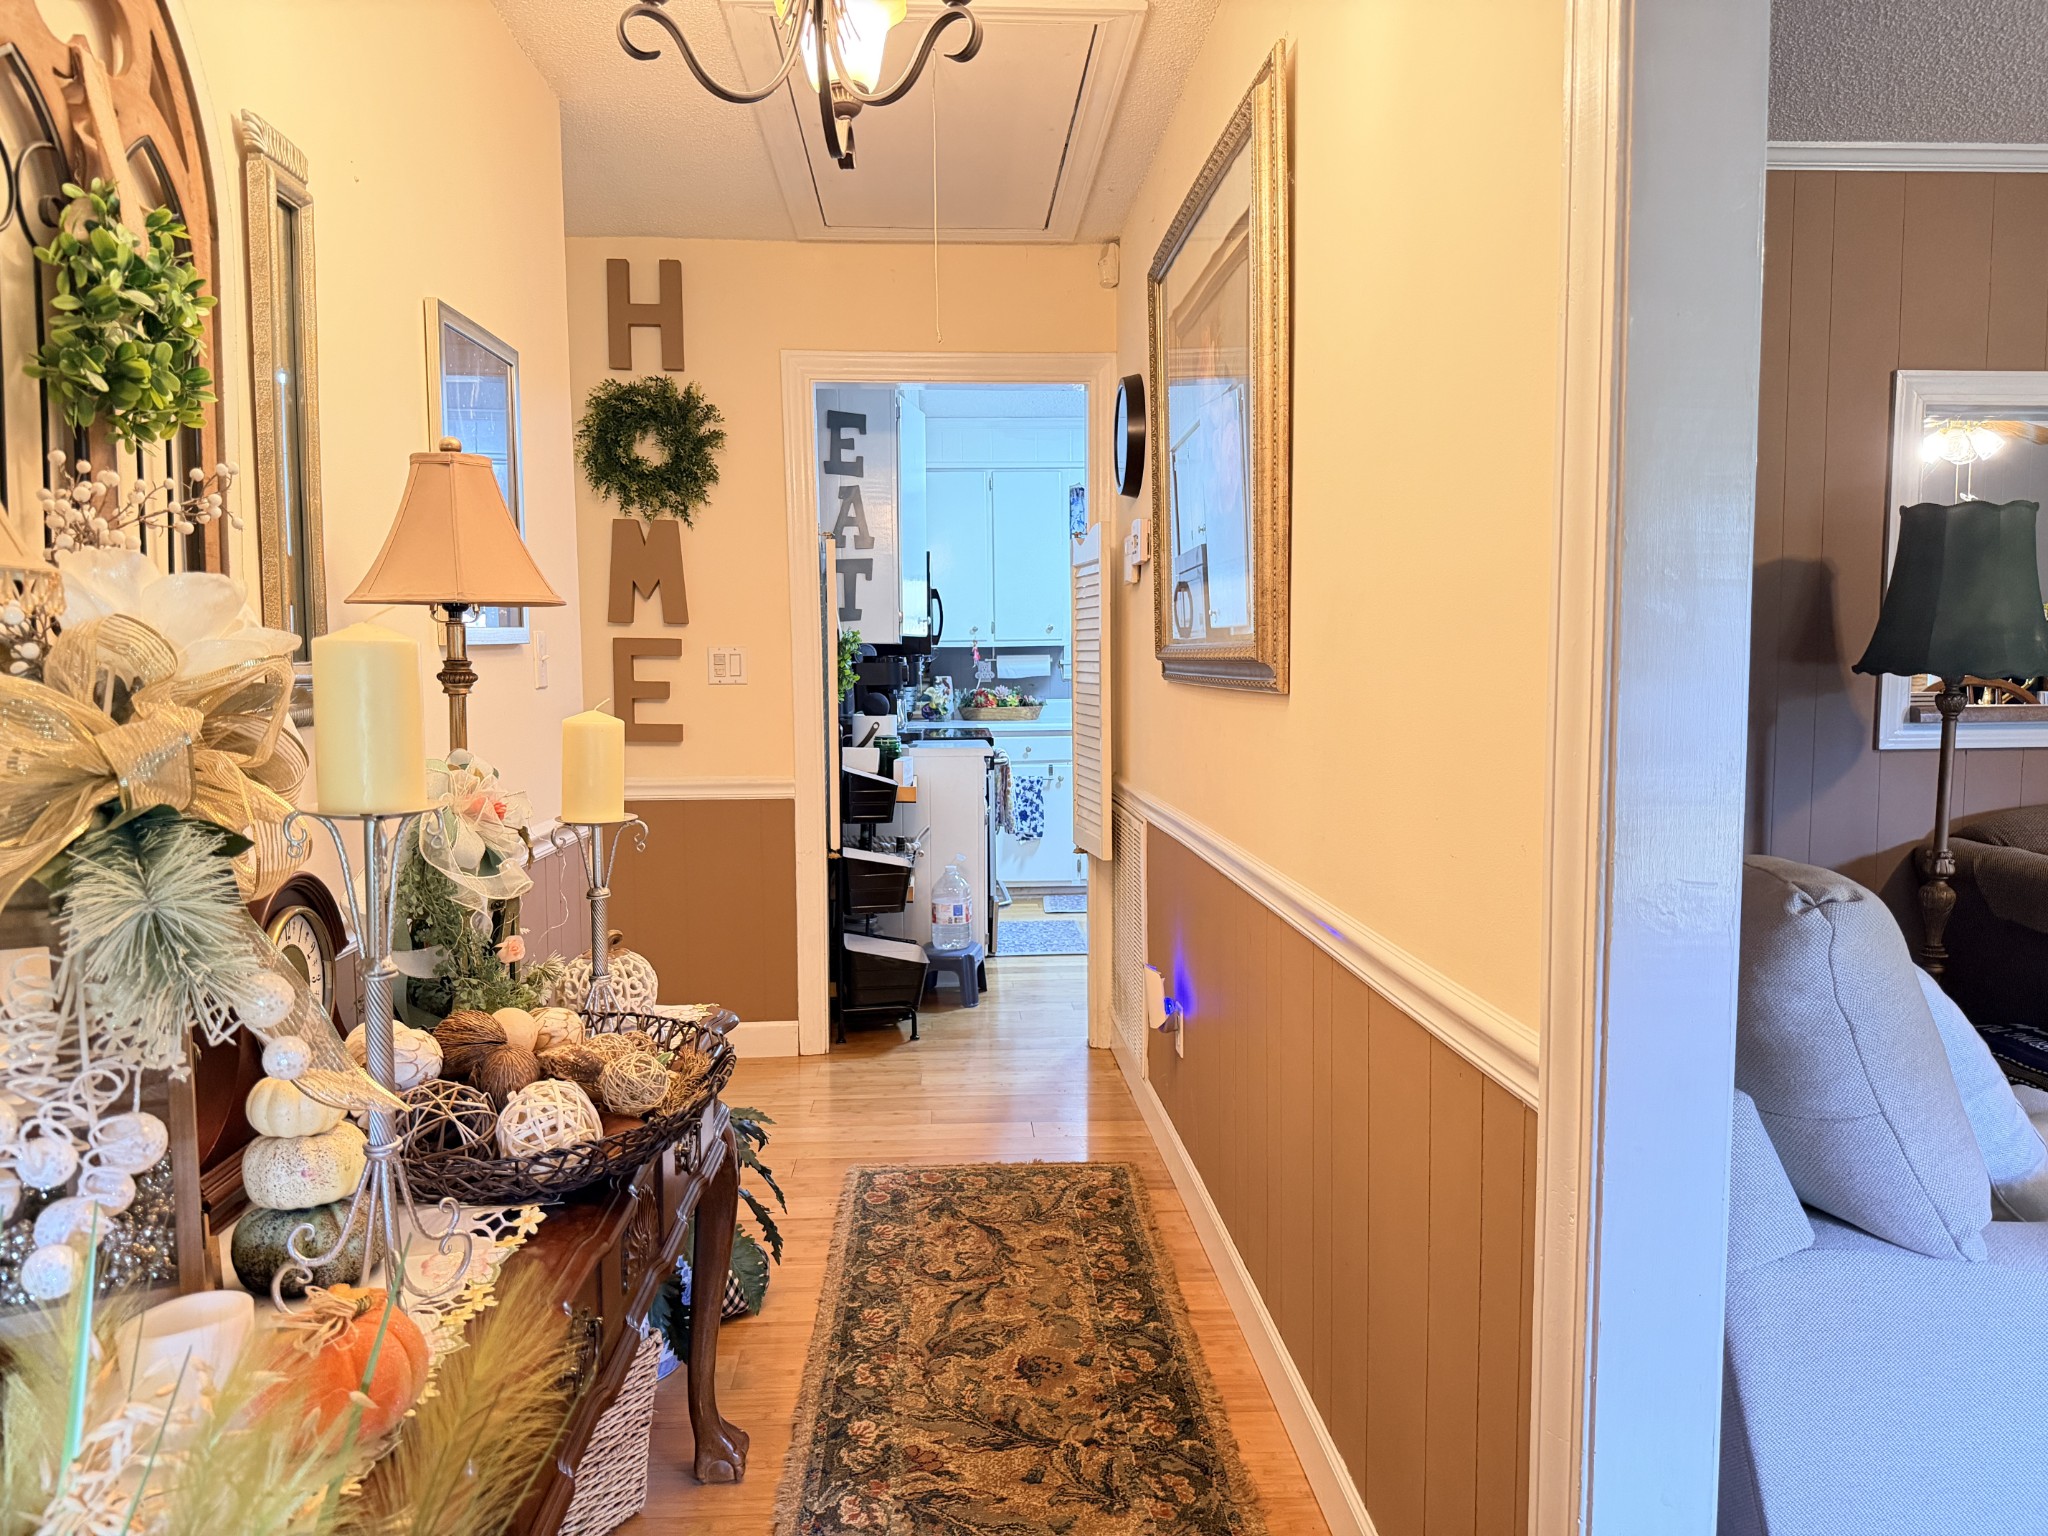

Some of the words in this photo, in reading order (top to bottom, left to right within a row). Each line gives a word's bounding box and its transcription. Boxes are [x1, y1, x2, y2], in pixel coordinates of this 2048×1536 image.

[823, 410, 875, 622] EAT
[284, 920, 291, 942] 12
[298, 921, 304, 943] 1
[307, 941, 316, 960] 2
[311, 974, 321, 984] 3
